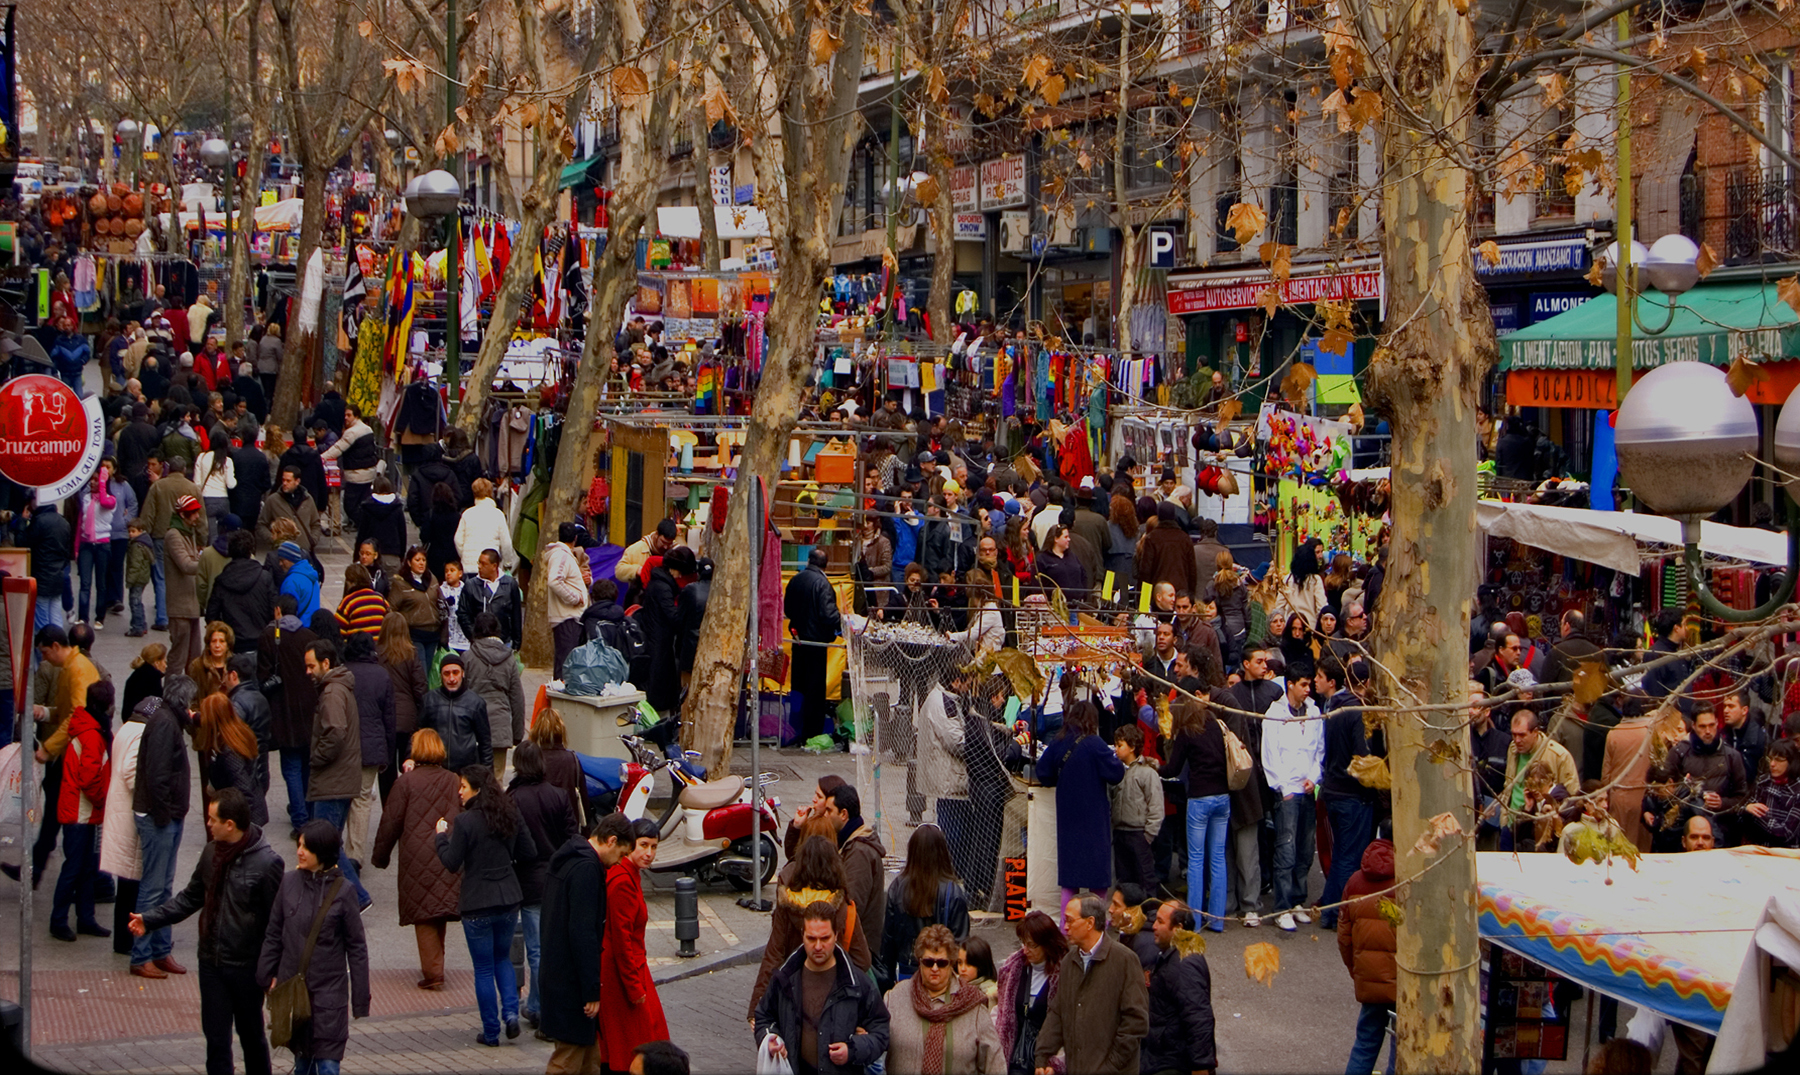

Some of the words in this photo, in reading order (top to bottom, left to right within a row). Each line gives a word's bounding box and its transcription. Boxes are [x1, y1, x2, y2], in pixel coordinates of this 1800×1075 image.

[957, 214, 982, 224] DEPORTES
[959, 222, 980, 232] SNOW
[1151, 231, 1173, 264] P
[1351, 275, 1381, 297] BAZA
[1535, 297, 1591, 312] ALMONE
[1511, 340, 1583, 367] ALIMENTACION
[1588, 340, 1611, 367] PAN
[1631, 339, 1660, 366] UTOS
[1664, 336, 1699, 364] SECOS
[1708, 334, 1717, 362] Y
[1533, 375, 1612, 403] BOCADILL
[0, 438, 81, 456] Cruzcampo
[55, 475, 83, 496] TOMA
[81, 453, 97, 475] QUE
[92, 417, 102, 448] TOMA
[1005, 858, 1025, 920] PLATA
